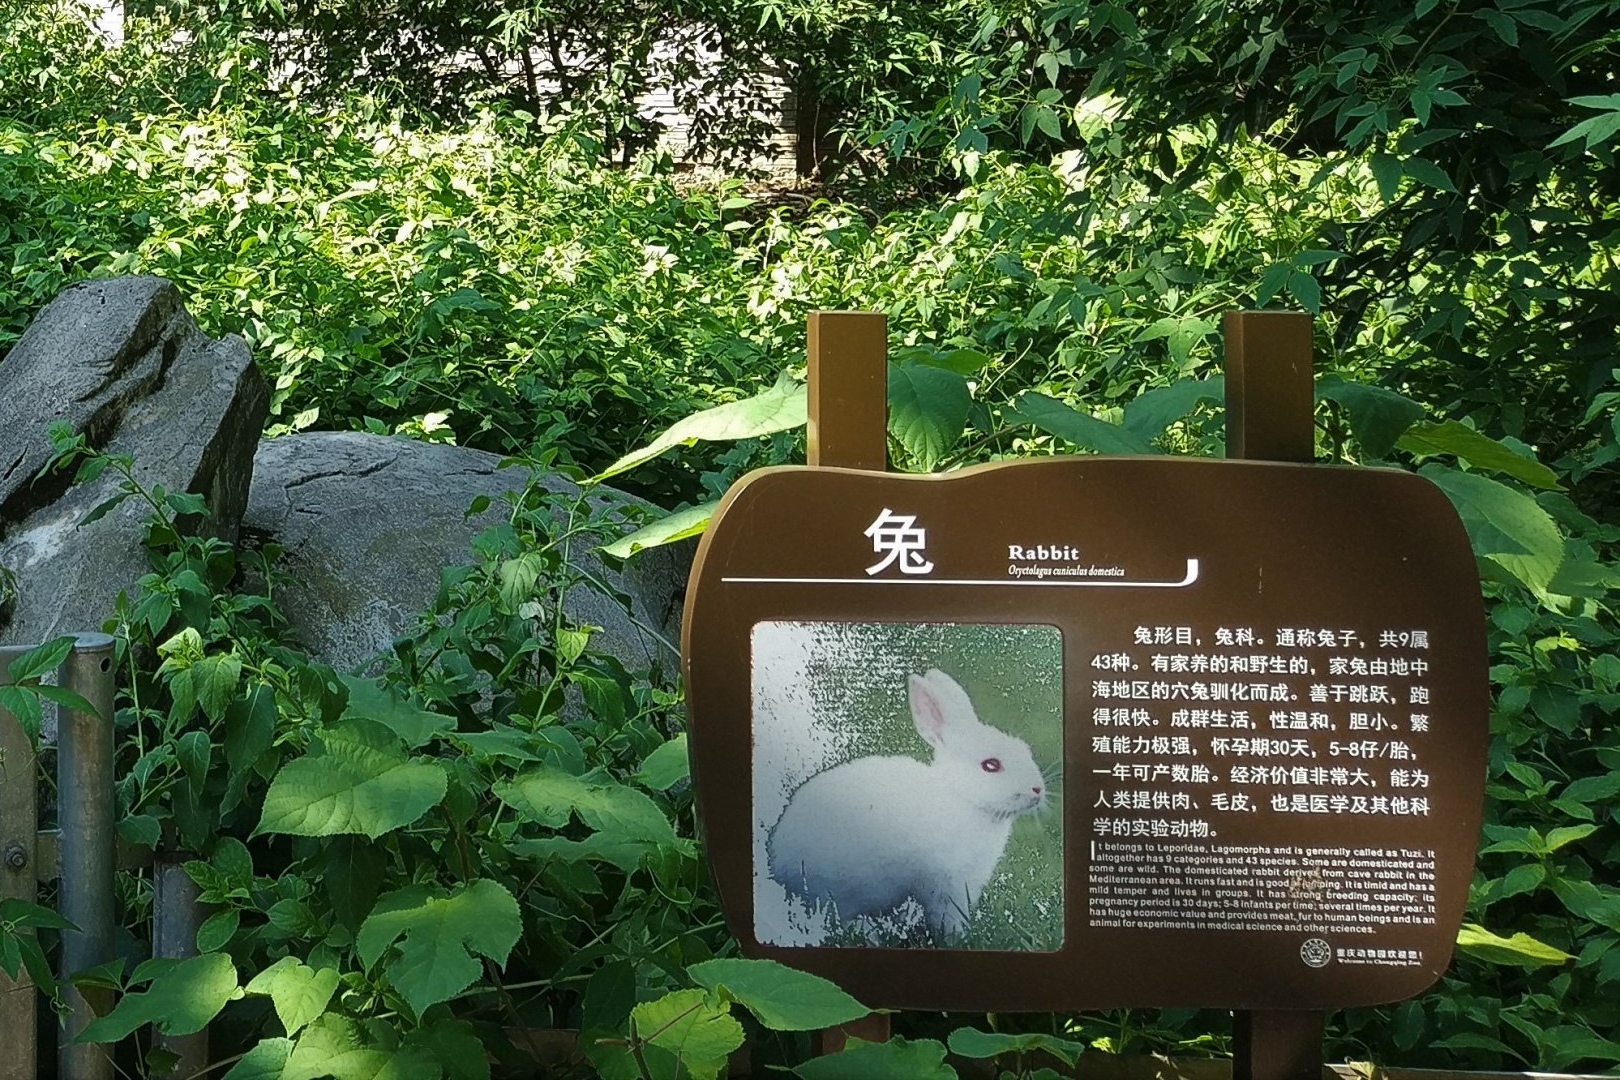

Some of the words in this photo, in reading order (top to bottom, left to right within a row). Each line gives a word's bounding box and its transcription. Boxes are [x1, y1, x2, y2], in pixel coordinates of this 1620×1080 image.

[864, 508, 934, 576] 兔
[1008, 545, 1079, 560] Rabbit
[1088, 564, 1125, 576] domestica
[1093, 818, 1218, 838] 学的实验动物。
[1105, 841, 1142, 854] belongs
[1145, 842, 1154, 852] to
[1211, 844, 1271, 857] Lagomorpha
[1273, 845, 1292, 855] and
[1294, 846, 1303, 855] is
[1305, 846, 1351, 859] generally
[1353, 847, 1383, 857] called
[1385, 850, 1398, 858] as
[1427, 849, 1435, 859] It
[1097, 852, 1145, 864] altogether
[1146, 853, 1164, 863] has
[1166, 854, 1172, 863] 9
[1174, 854, 1224, 866] categories
[1226, 855, 1244, 865] and
[1245, 856, 1258, 865] 43
[1302, 857, 1330, 867] Some
[1349, 858, 1414, 869] domesticated
[1416, 860, 1435, 869] and
[1089, 865, 1114, 873] some
[1163, 865, 1181, 874] The
[1184, 865, 1248, 876] domesticated
[1252, 867, 1280, 877] rabbit
[1322, 868, 1344, 878] from
[1347, 871, 1371, 879] cave
[1374, 870, 1403, 880] rabbit
[1406, 870, 1416, 880] in
[1418, 871, 1435, 880] the
[1185, 876, 1192, 886] It
[1194, 878, 1215, 886] runs
[1216, 877, 1235, 887] fast
[1236, 877, 1254, 887] and
[1256, 878, 1264, 887] is
[1265, 878, 1290, 890] good
[1345, 880, 1353, 889] It
[1353, 880, 1363, 890] is
[1363, 880, 1388, 890] timid
[1389, 881, 1408, 891] and
[1409, 882, 1427, 891] has
[1089, 885, 1109, 895] mild
[1114, 885, 1147, 897] temper
[1152, 886, 1169, 896] and
[1174, 887, 1197, 897] lives
[1202, 888, 1210, 897] in
[1256, 889, 1264, 898] It
[1268, 889, 1286, 899] has
[1326, 891, 1369, 903] breeding
[1423, 893, 1435, 902] its
[1089, 898, 1139, 908] pregnancy
[1140, 897, 1170, 909] period
[1172, 898, 1180, 907] is
[1182, 898, 1194, 908] 30
[1223, 899, 1239, 909] 5-8
[1241, 899, 1274, 909] infants
[1275, 902, 1291, 912] per
[1318, 901, 1354, 911] several
[1355, 902, 1382, 912] times
[1383, 905, 1400, 914] per
[1428, 904, 1436, 913] It
[1089, 907, 1106, 916] has
[1108, 907, 1132, 919] huge
[1133, 908, 1178, 918] economic
[1180, 909, 1206, 919] value
[1208, 910, 1225, 919] and
[1227, 910, 1268, 922] provides
[1298, 912, 1312, 921] fur
[1313, 912, 1323, 922] to
[1324, 912, 1357, 922] human
[1358, 913, 1391, 925] beings
[1392, 914, 1411, 924] and
[1412, 915, 1421, 924] is
[1090, 918, 1121, 928] animal
[1123, 919, 1136, 928] for
[1137, 919, 1195, 932] experiments
[1197, 920, 1205, 930] in
[1207, 921, 1244, 931] medical
[1246, 922, 1283, 932] science
[1284, 923, 1302, 932] and
[1303, 923, 1329, 933] other
